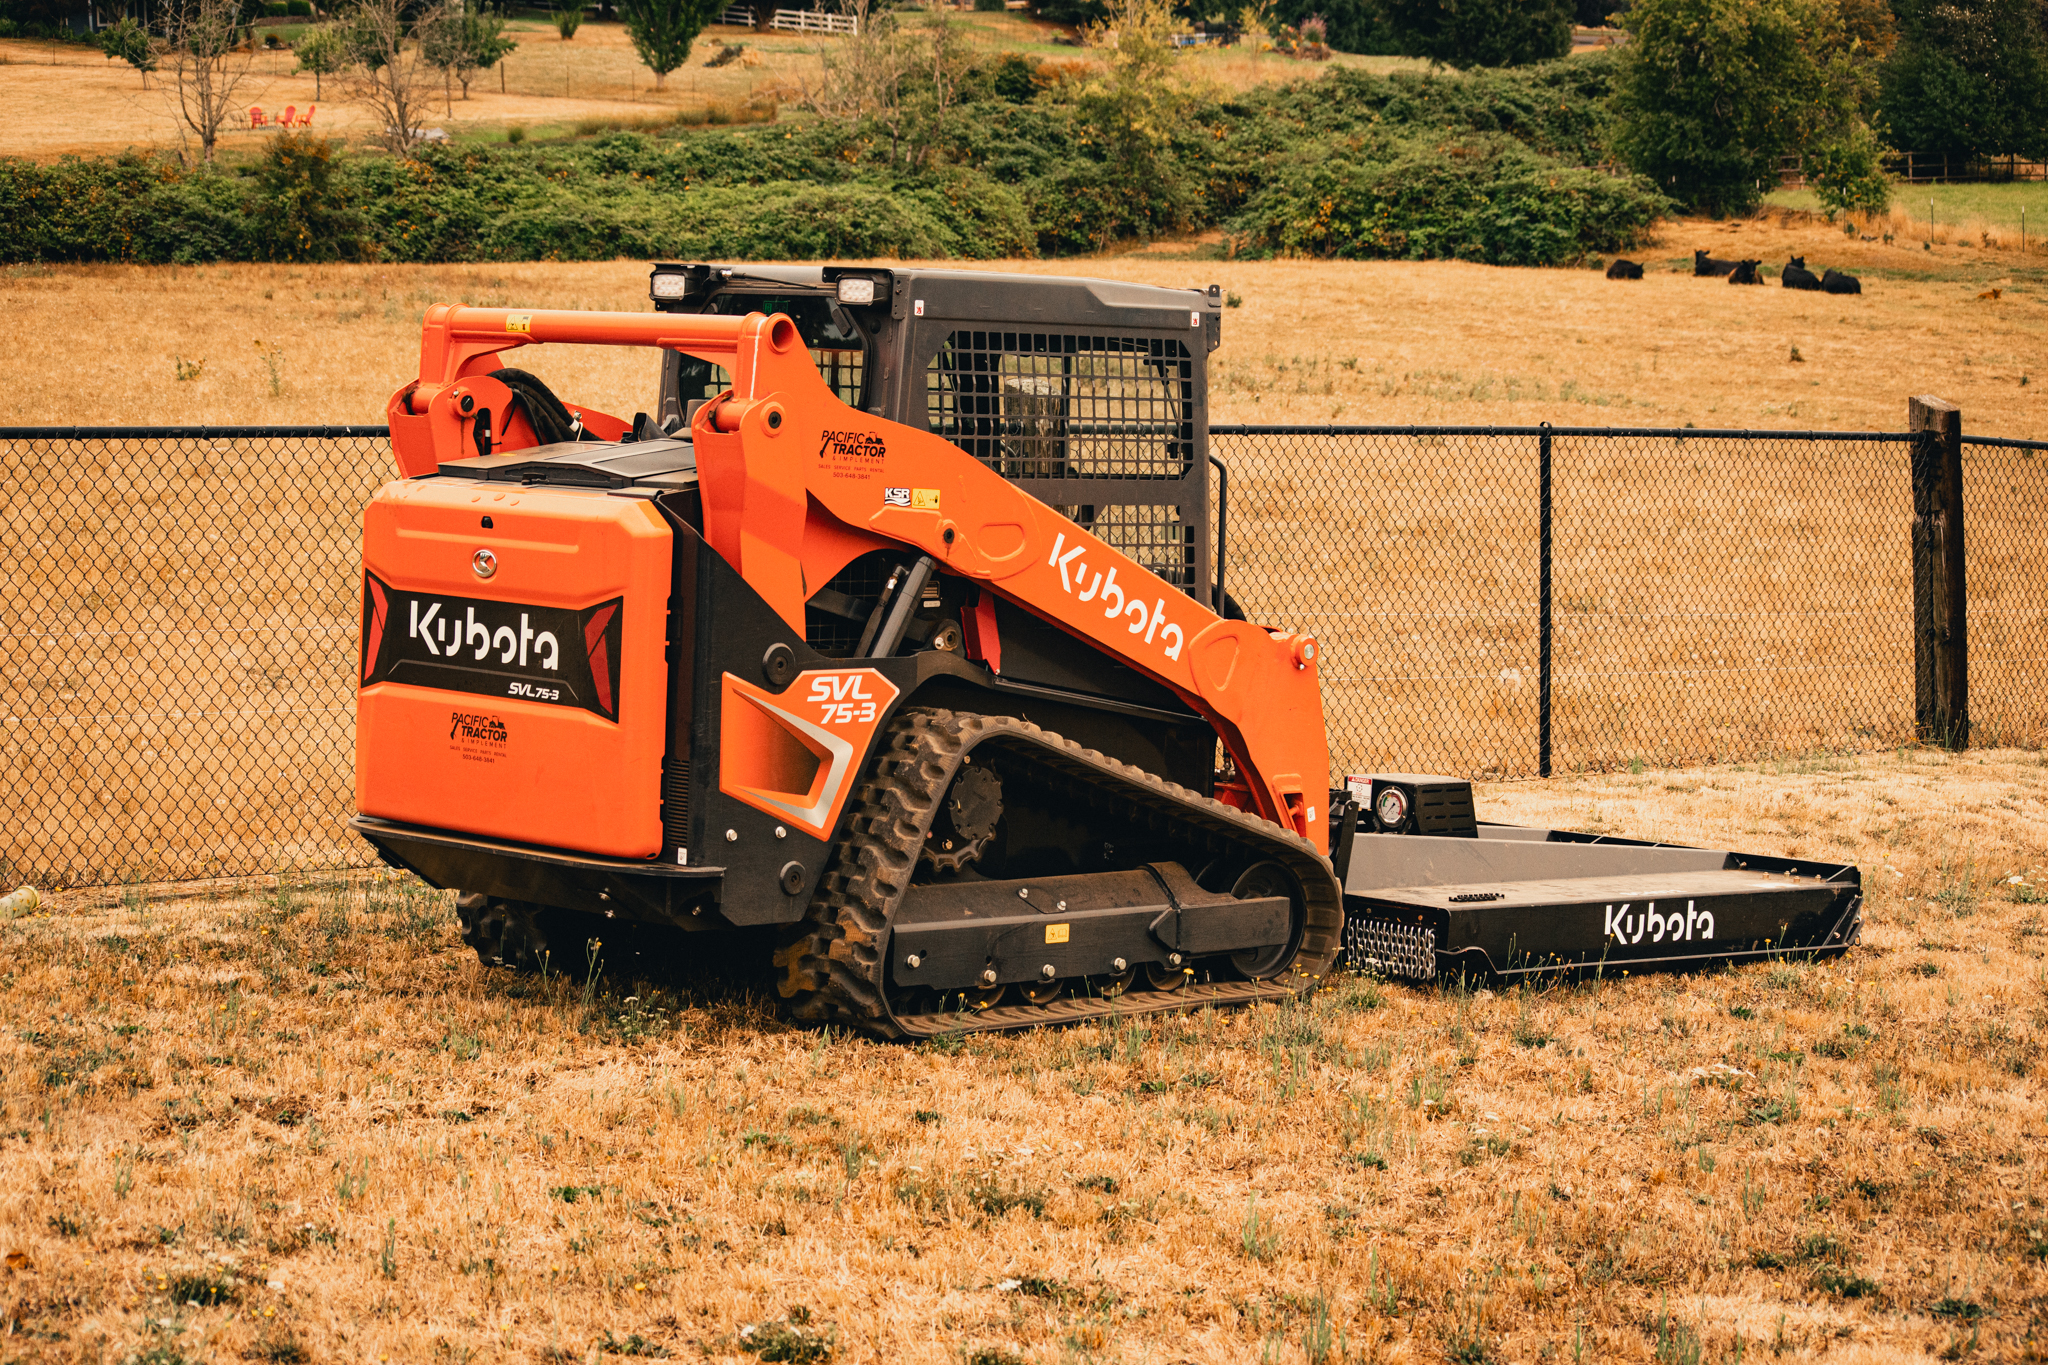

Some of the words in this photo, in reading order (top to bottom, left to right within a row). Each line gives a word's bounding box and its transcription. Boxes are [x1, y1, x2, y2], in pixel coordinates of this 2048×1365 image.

[821, 430, 865, 444] PACIFIC
[833, 443, 886, 457] TRACTOR
[839, 456, 884, 464] IMPLEMENT
[885, 487, 910, 499] KSR
[1048, 532, 1184, 661] Kubota
[409, 600, 559, 670] Kubota
[807, 675, 873, 702] SVL
[451, 712, 489, 728] PACIFIC
[821, 702, 877, 724] 75-3
[461, 725, 508, 742] TRACTOR
[467, 738, 507, 749] IMPLEMENT
[1604, 900, 1715, 945] Kubota
